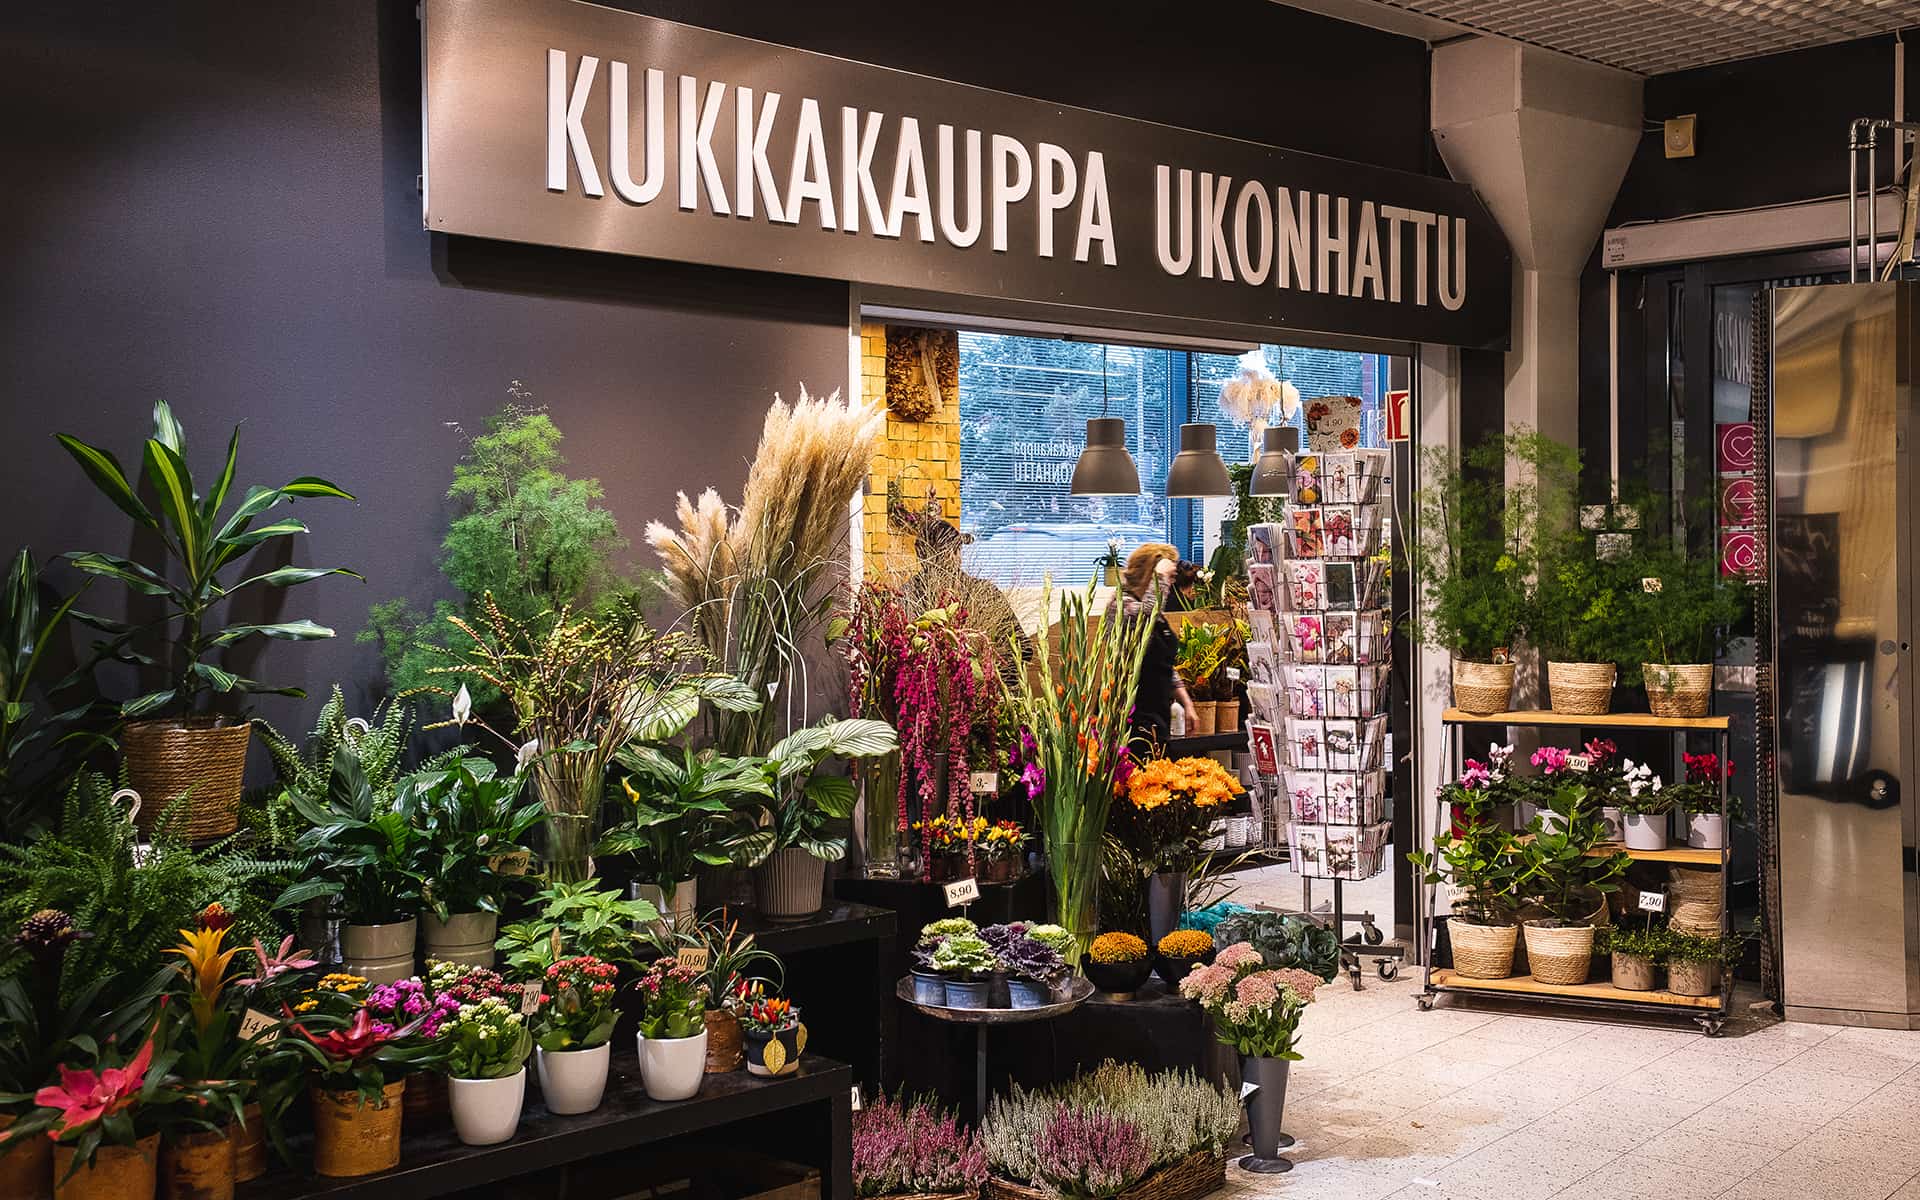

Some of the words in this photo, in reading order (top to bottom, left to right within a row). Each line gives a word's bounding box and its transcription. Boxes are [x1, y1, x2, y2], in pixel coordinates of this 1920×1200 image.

[547, 49, 1117, 266] KUKKAKAUPPA
[1156, 164, 1467, 311] UKONHATTU
[950, 884, 972, 899] 8,90
[680, 953, 706, 968] 10,90
